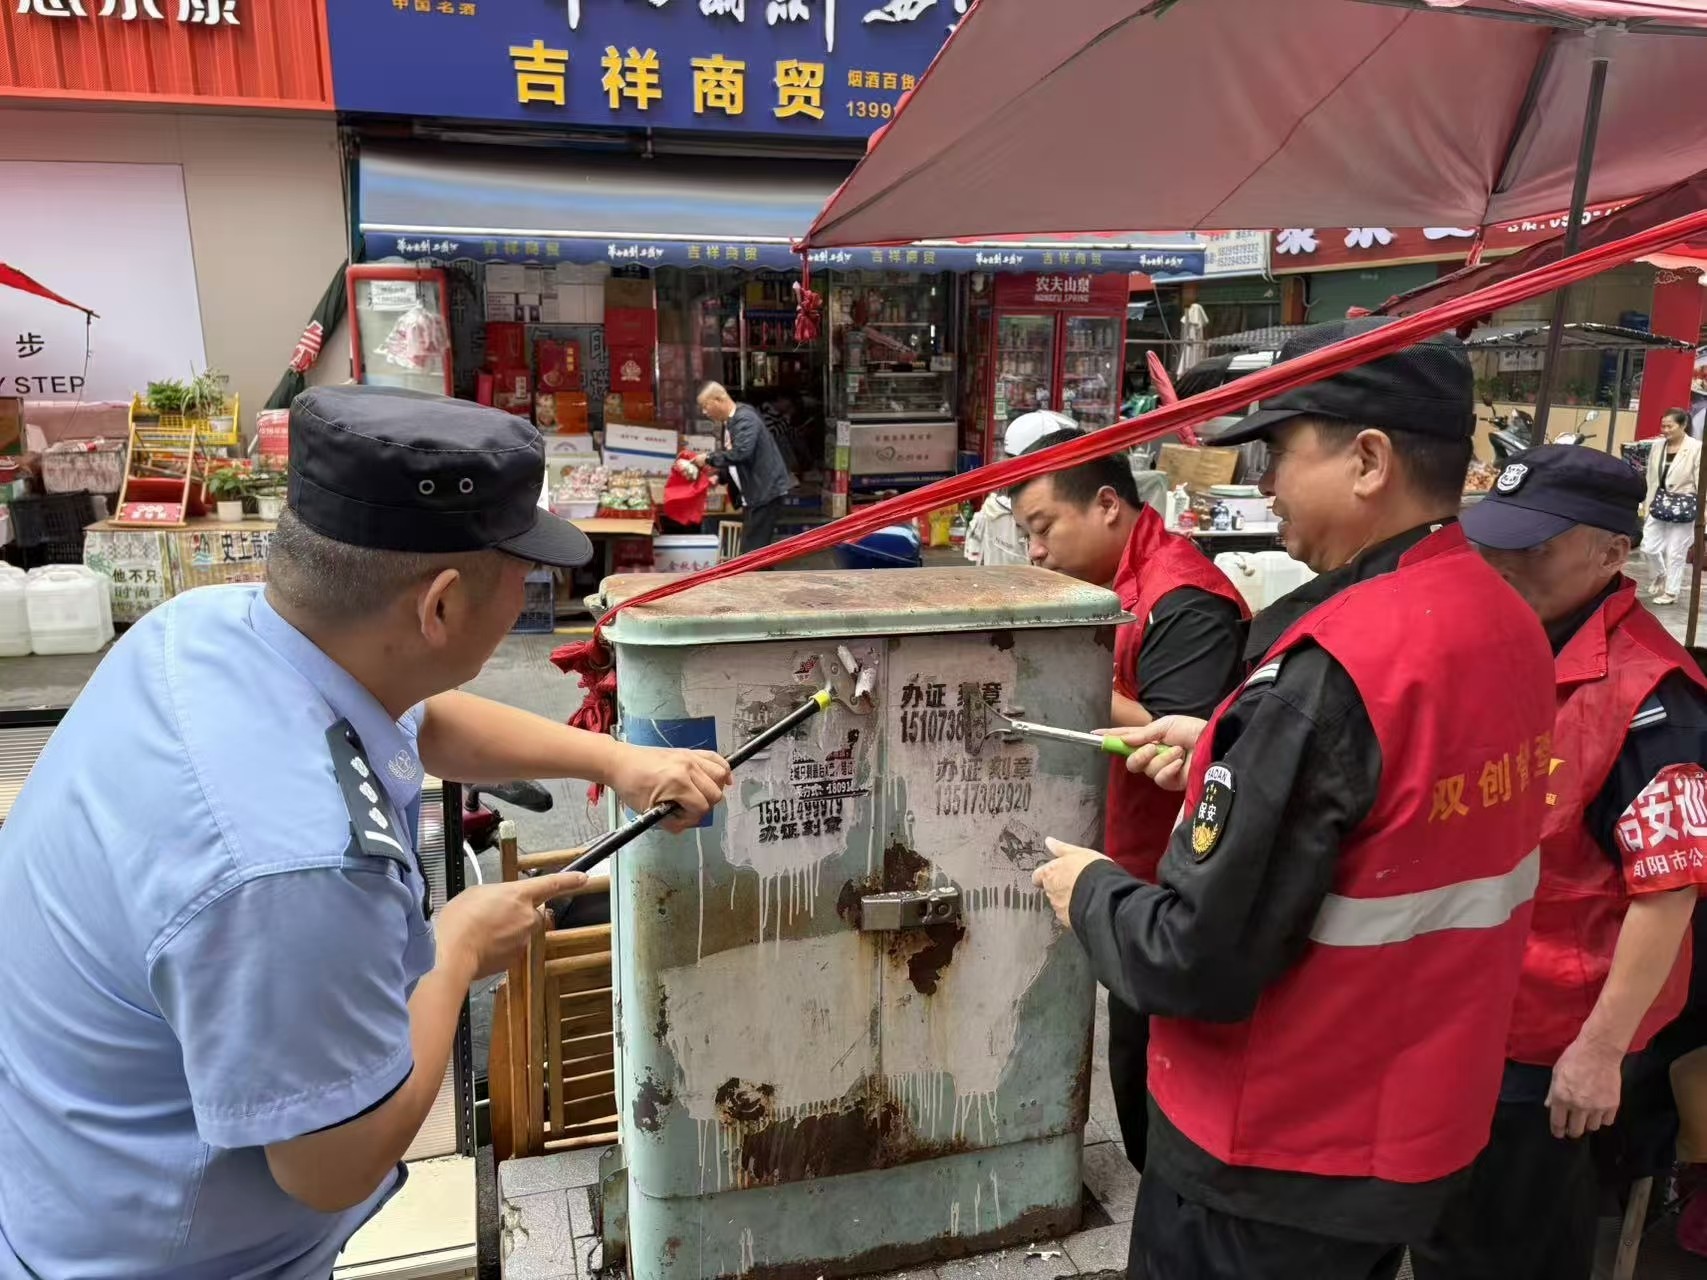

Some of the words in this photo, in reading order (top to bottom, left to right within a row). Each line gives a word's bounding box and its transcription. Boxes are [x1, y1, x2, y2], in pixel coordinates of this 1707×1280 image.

[508, 39, 825, 120] 吉祥商贸
[847, 69, 916, 91] 烟酒百货
[688, 245, 758, 261] 吉祥商贸
[871, 249, 936, 265] 吉祥商贸
[1035, 276, 1090, 293] 农夫山泉
[16, 332, 44, 358] 步
[15, 375, 85, 394] STEP
[112, 568, 157, 584] 他不只
[901, 683, 946, 708] 办证
[935, 758, 982, 782] 办证
[988, 756, 1033, 780] 刻章
[1198, 802, 1217, 821] 保安
[1633, 847, 1704, 878] 旬阳市公
